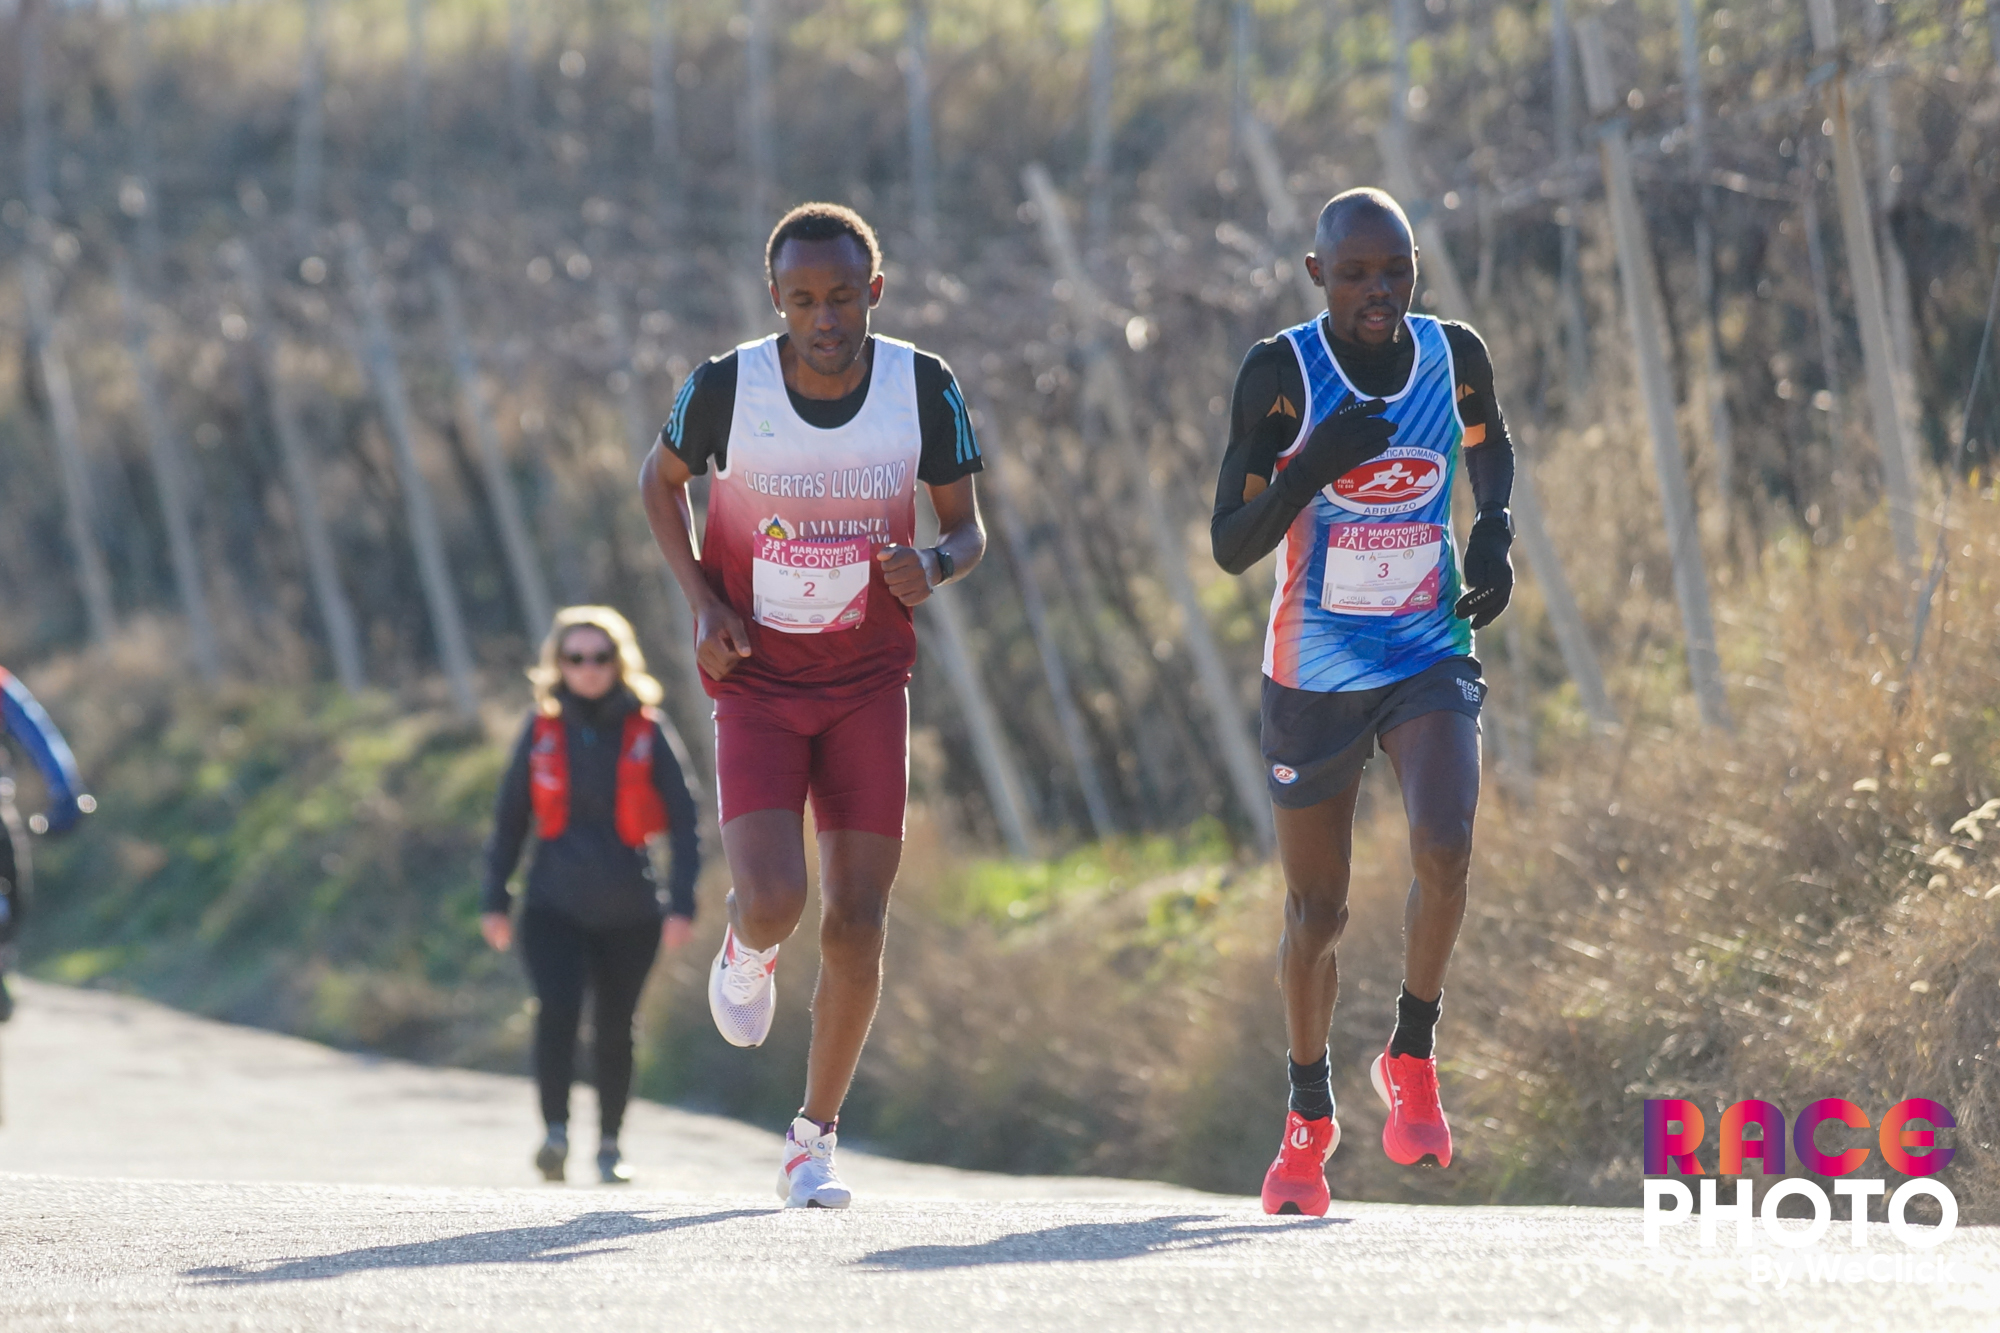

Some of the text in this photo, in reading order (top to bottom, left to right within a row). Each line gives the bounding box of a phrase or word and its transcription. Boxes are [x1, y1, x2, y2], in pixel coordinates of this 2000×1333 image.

[1339, 403, 1367, 415] KIPSTA
[1405, 448, 1439, 462] VOMANO
[744, 459, 907, 500] LIBERTAS LIVORNO
[1363, 502, 1417, 515] ABRUZZO
[1368, 523, 1430, 537] MARATONINA
[1337, 529, 1432, 550] FALCONERI
[761, 547, 860, 568] FALCONERI
[789, 544, 857, 556] MARATONINA
[1377, 562, 1389, 578] 3
[803, 581, 816, 597] 2
[1468, 588, 1494, 605] KIPSTA
